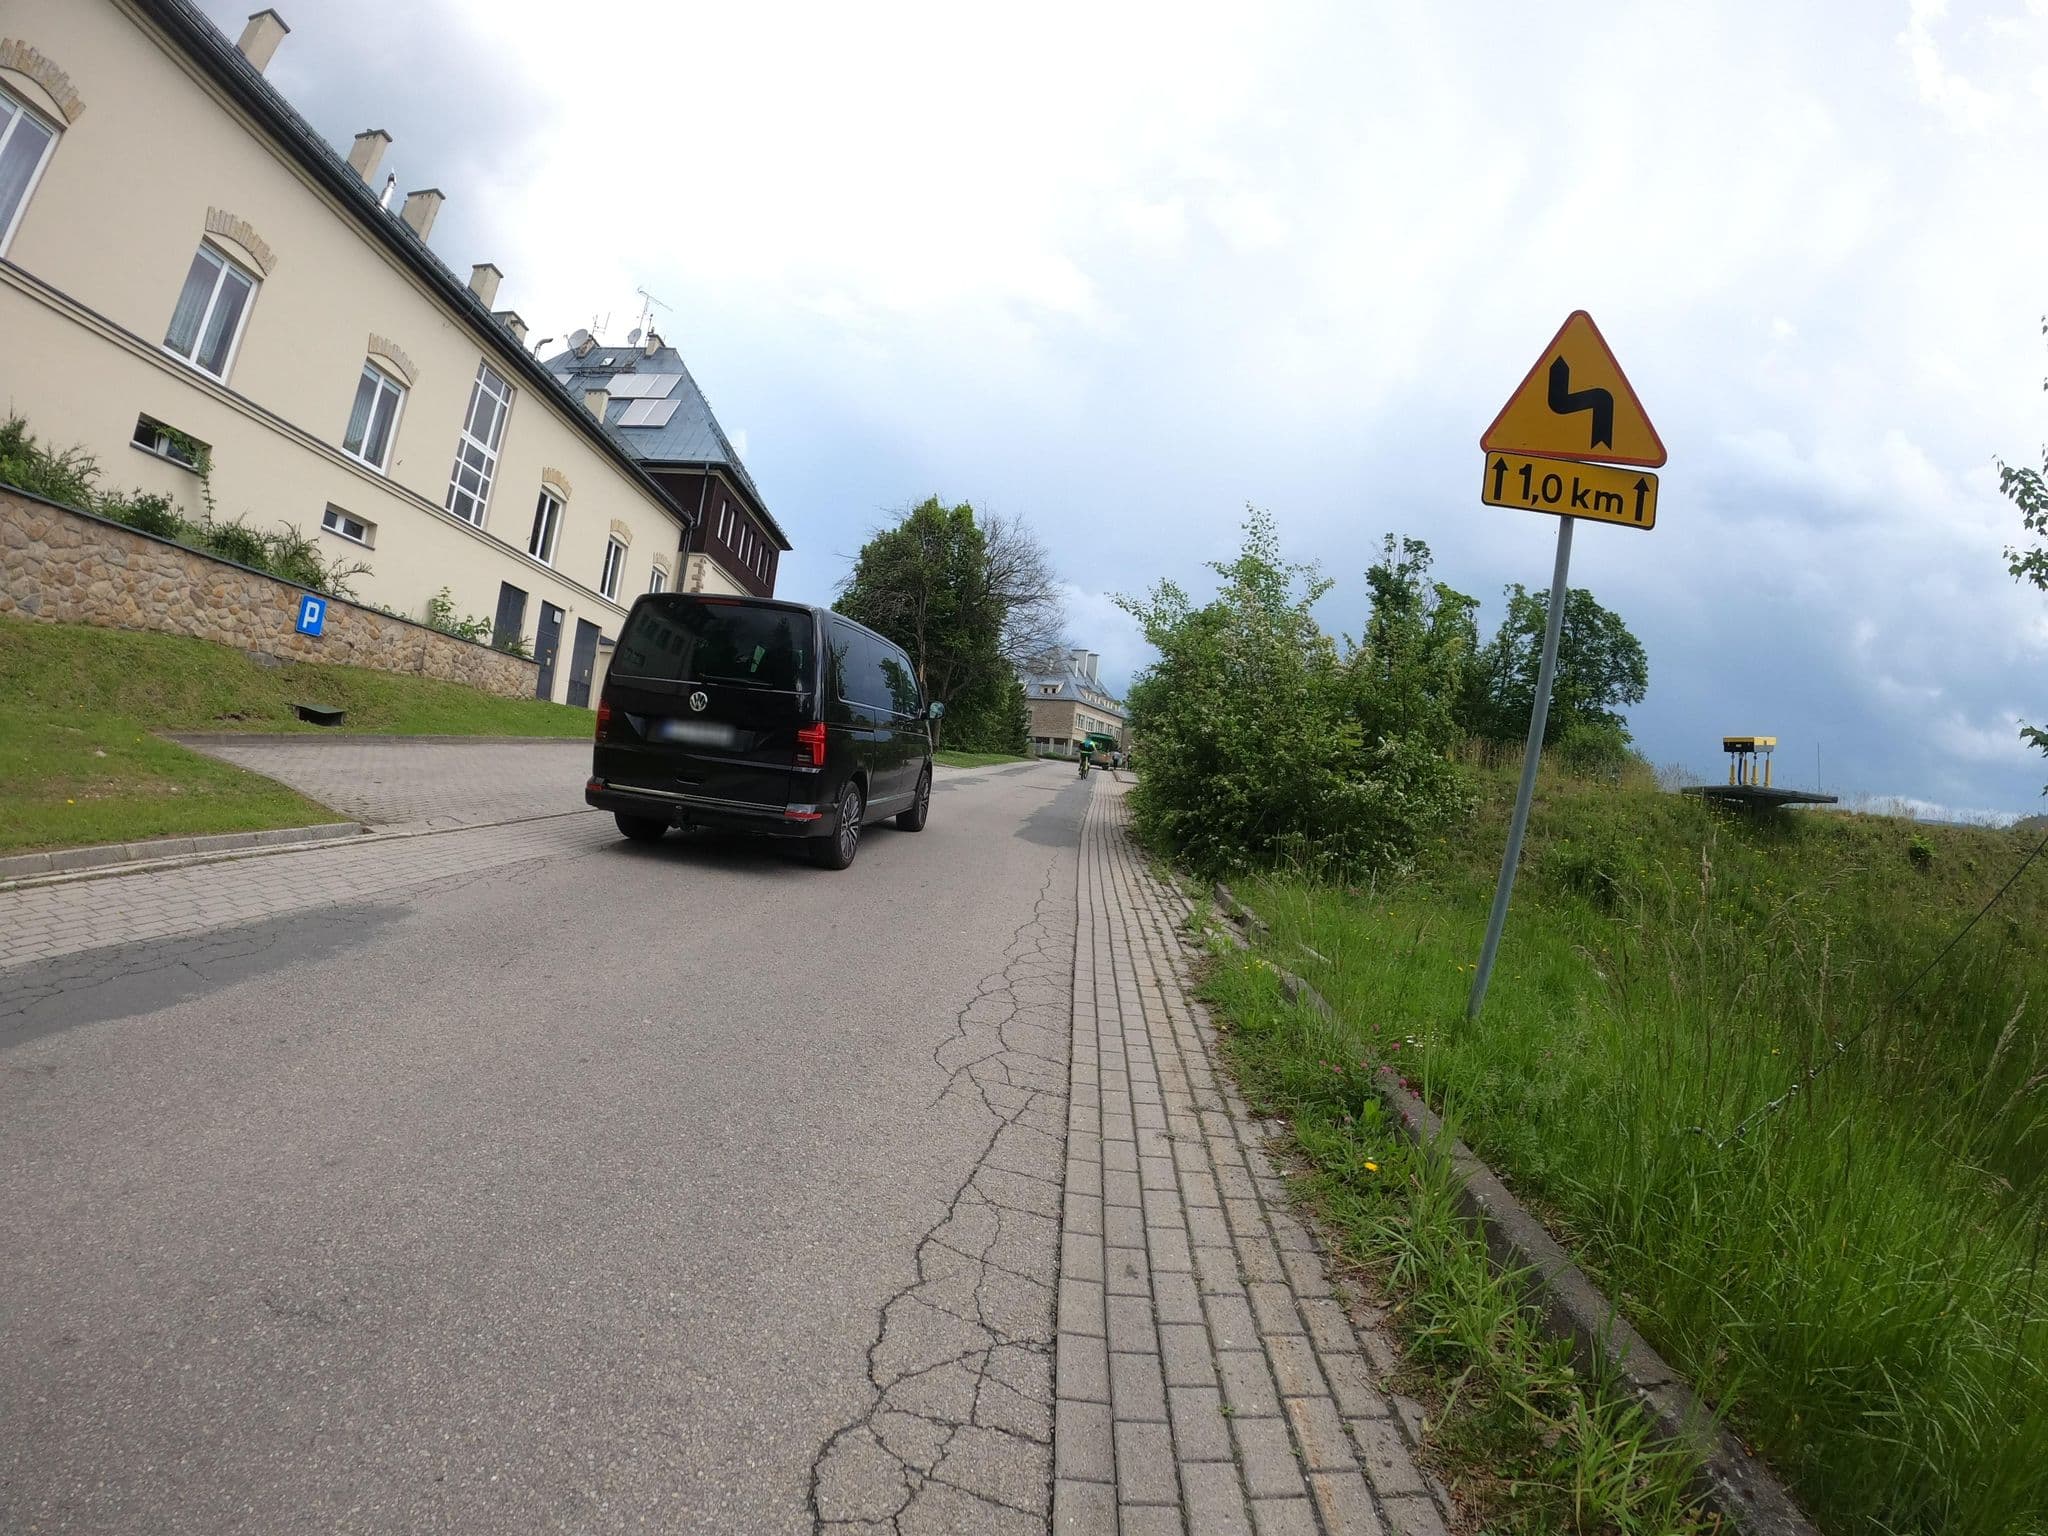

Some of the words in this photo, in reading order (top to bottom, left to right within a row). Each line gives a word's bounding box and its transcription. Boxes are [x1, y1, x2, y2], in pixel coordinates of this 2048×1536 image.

[1519, 464, 1562, 505] 1,0
[1571, 477, 1624, 515] km
[302, 601, 320, 628] P
